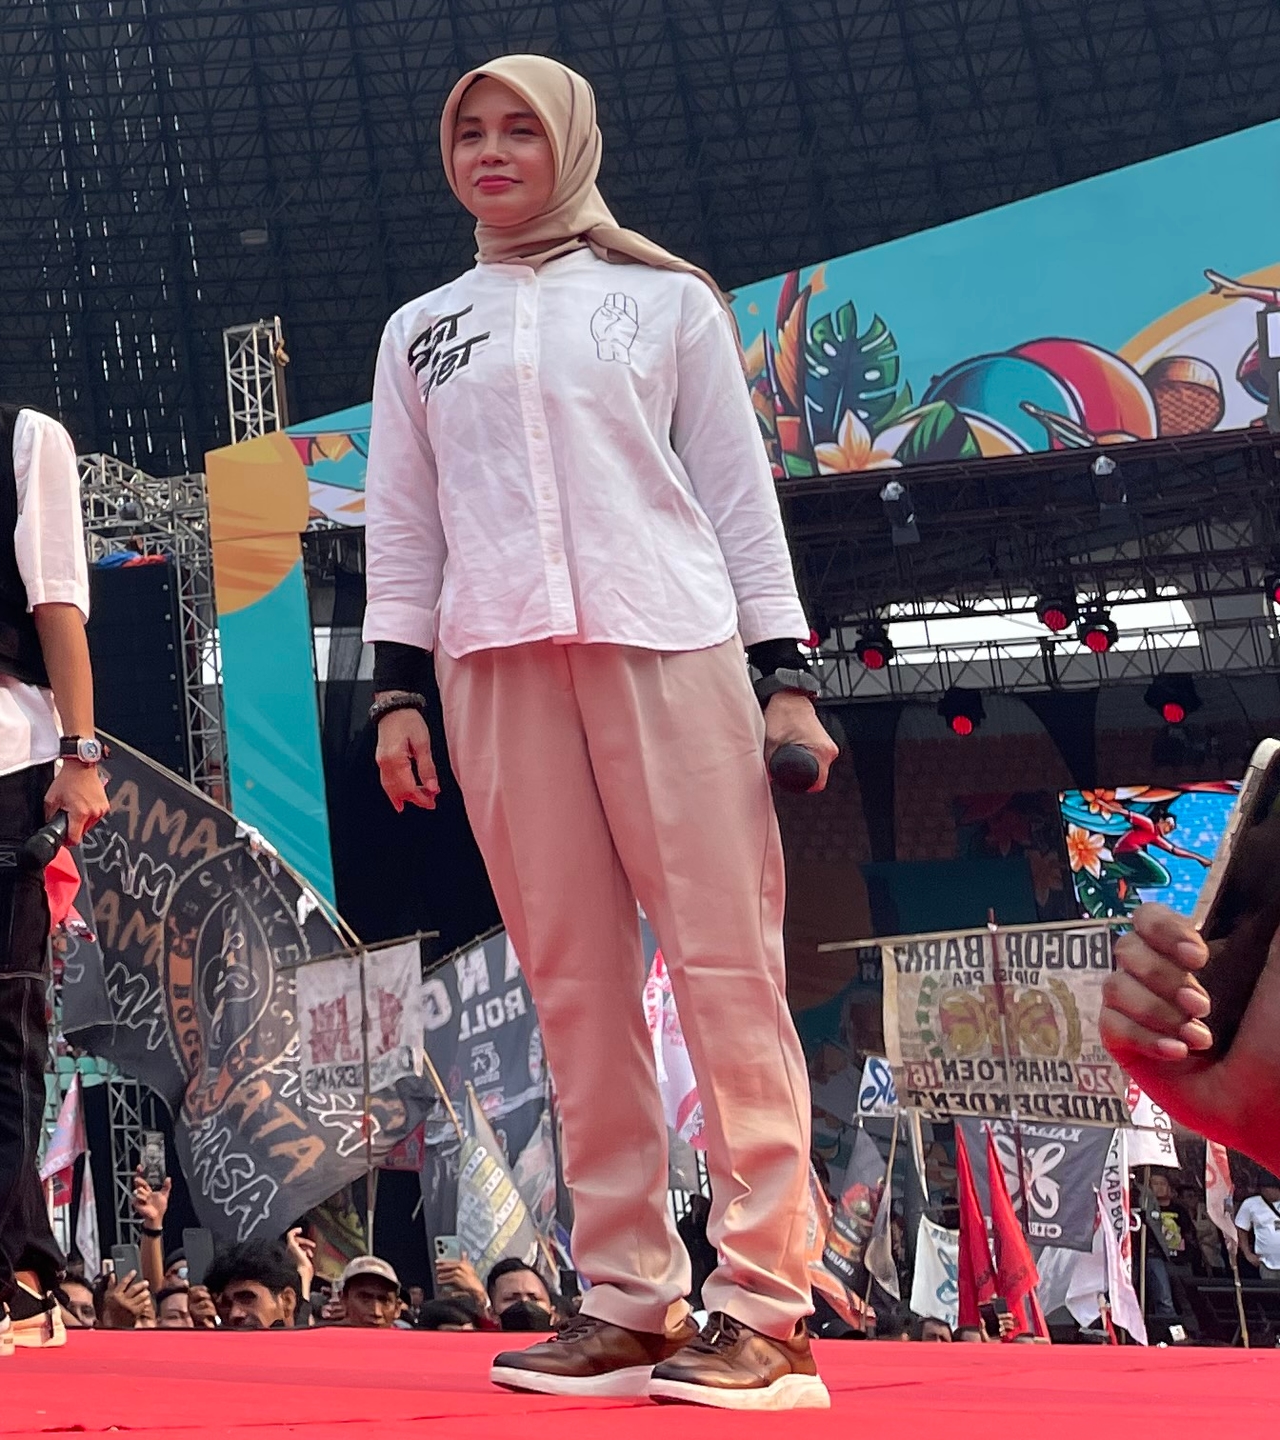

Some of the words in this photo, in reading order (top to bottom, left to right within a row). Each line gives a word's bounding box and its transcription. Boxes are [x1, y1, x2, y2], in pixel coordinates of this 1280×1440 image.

[109, 779, 221, 859] AMA
[228, 1078, 327, 1184] ATA
[1149, 1103, 1173, 1155] OGOR
[1102, 1166, 1123, 1202] KAB
